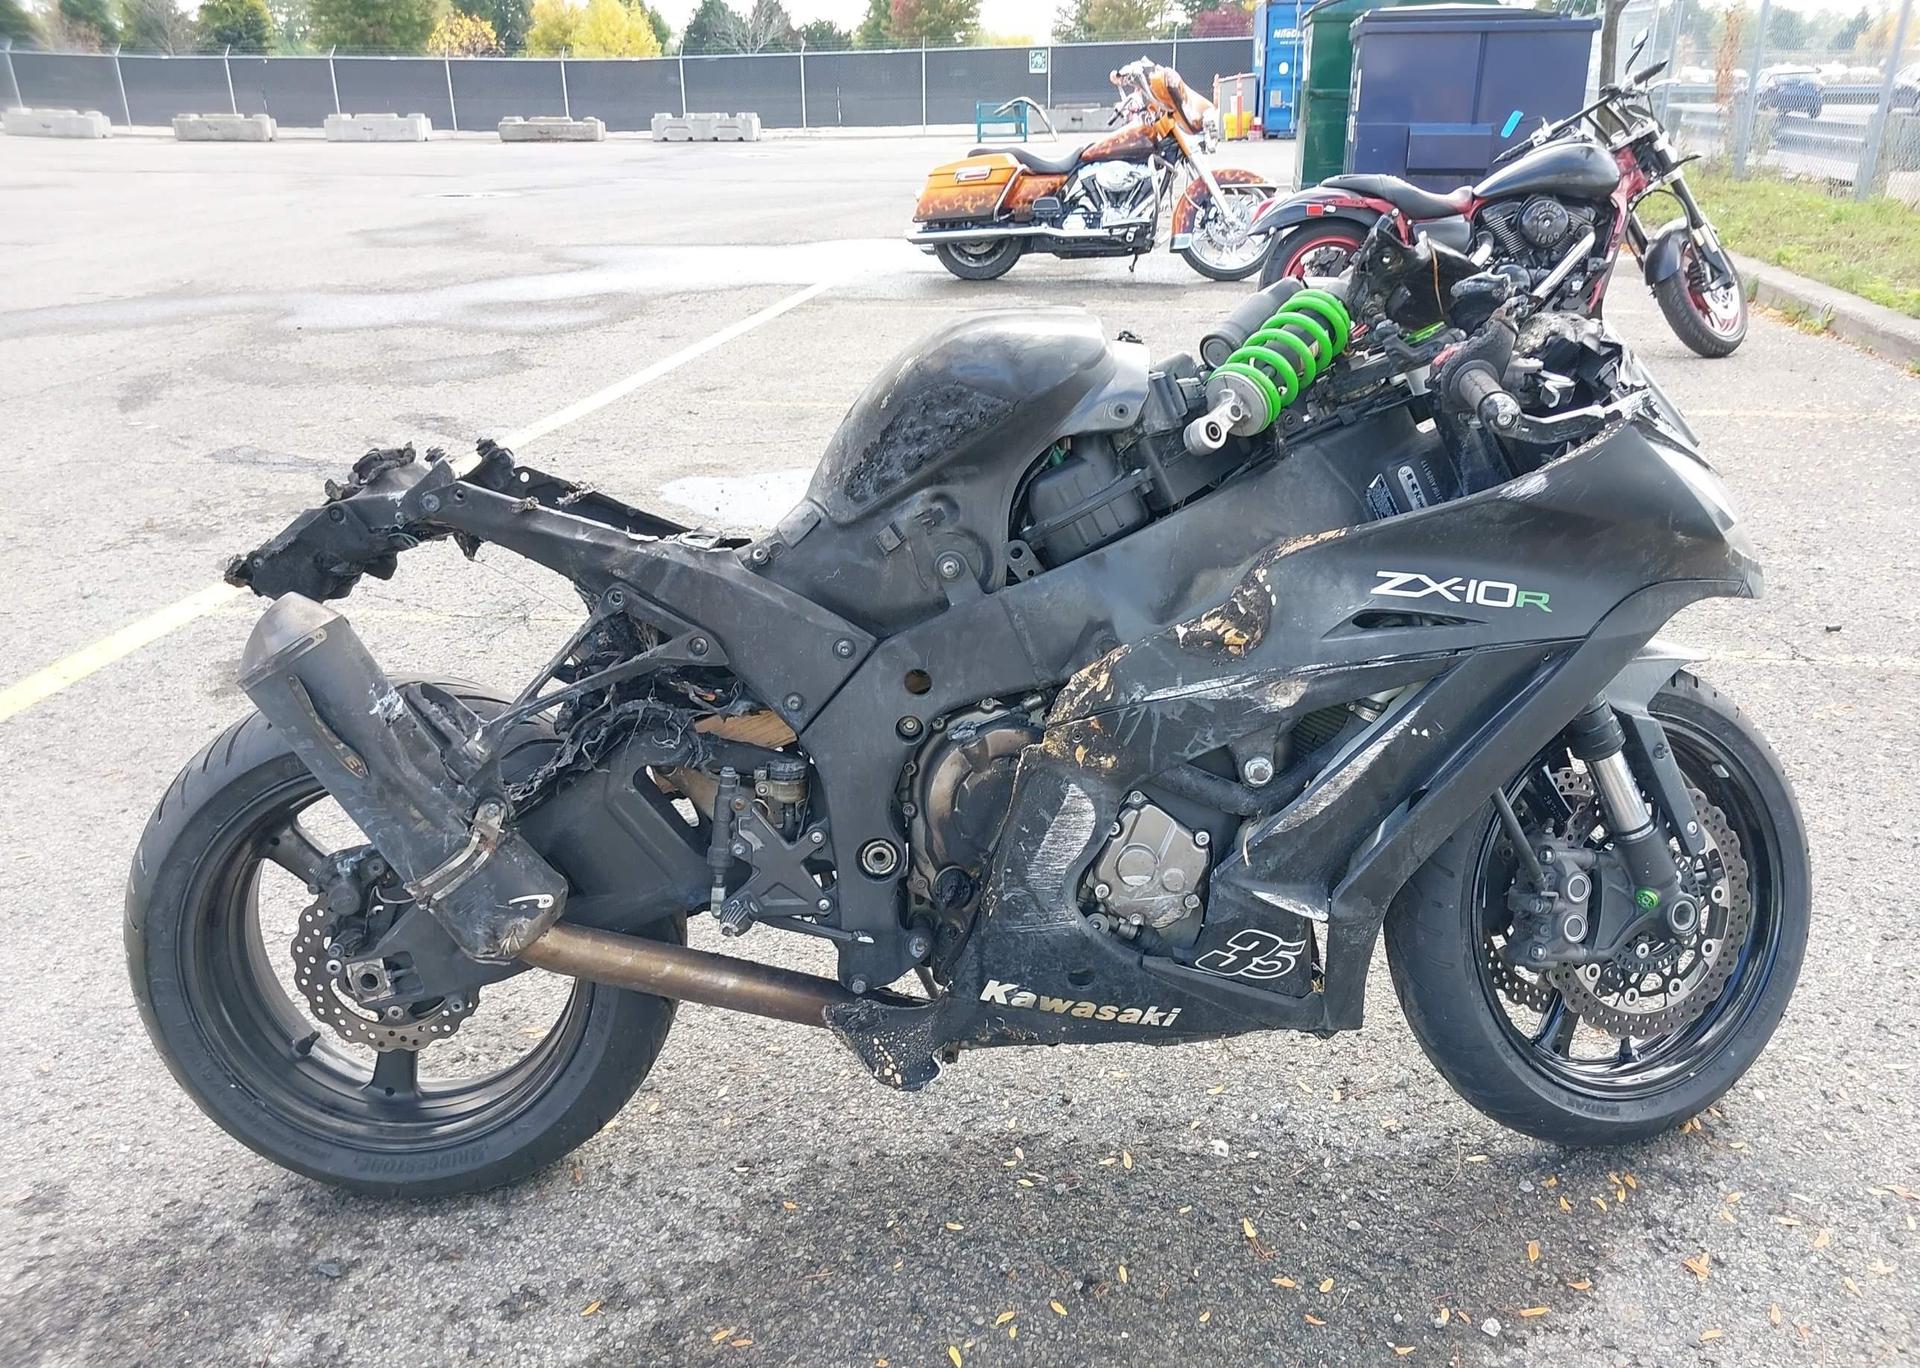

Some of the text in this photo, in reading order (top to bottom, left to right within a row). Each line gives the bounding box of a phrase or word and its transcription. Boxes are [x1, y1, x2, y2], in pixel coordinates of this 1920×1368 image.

[1370, 570, 1553, 613] ZX-10R
[1195, 928, 1307, 979] 35
[979, 979, 1183, 1027] Kawasaki
[356, 1145, 485, 1175] BRIDGESTONE
